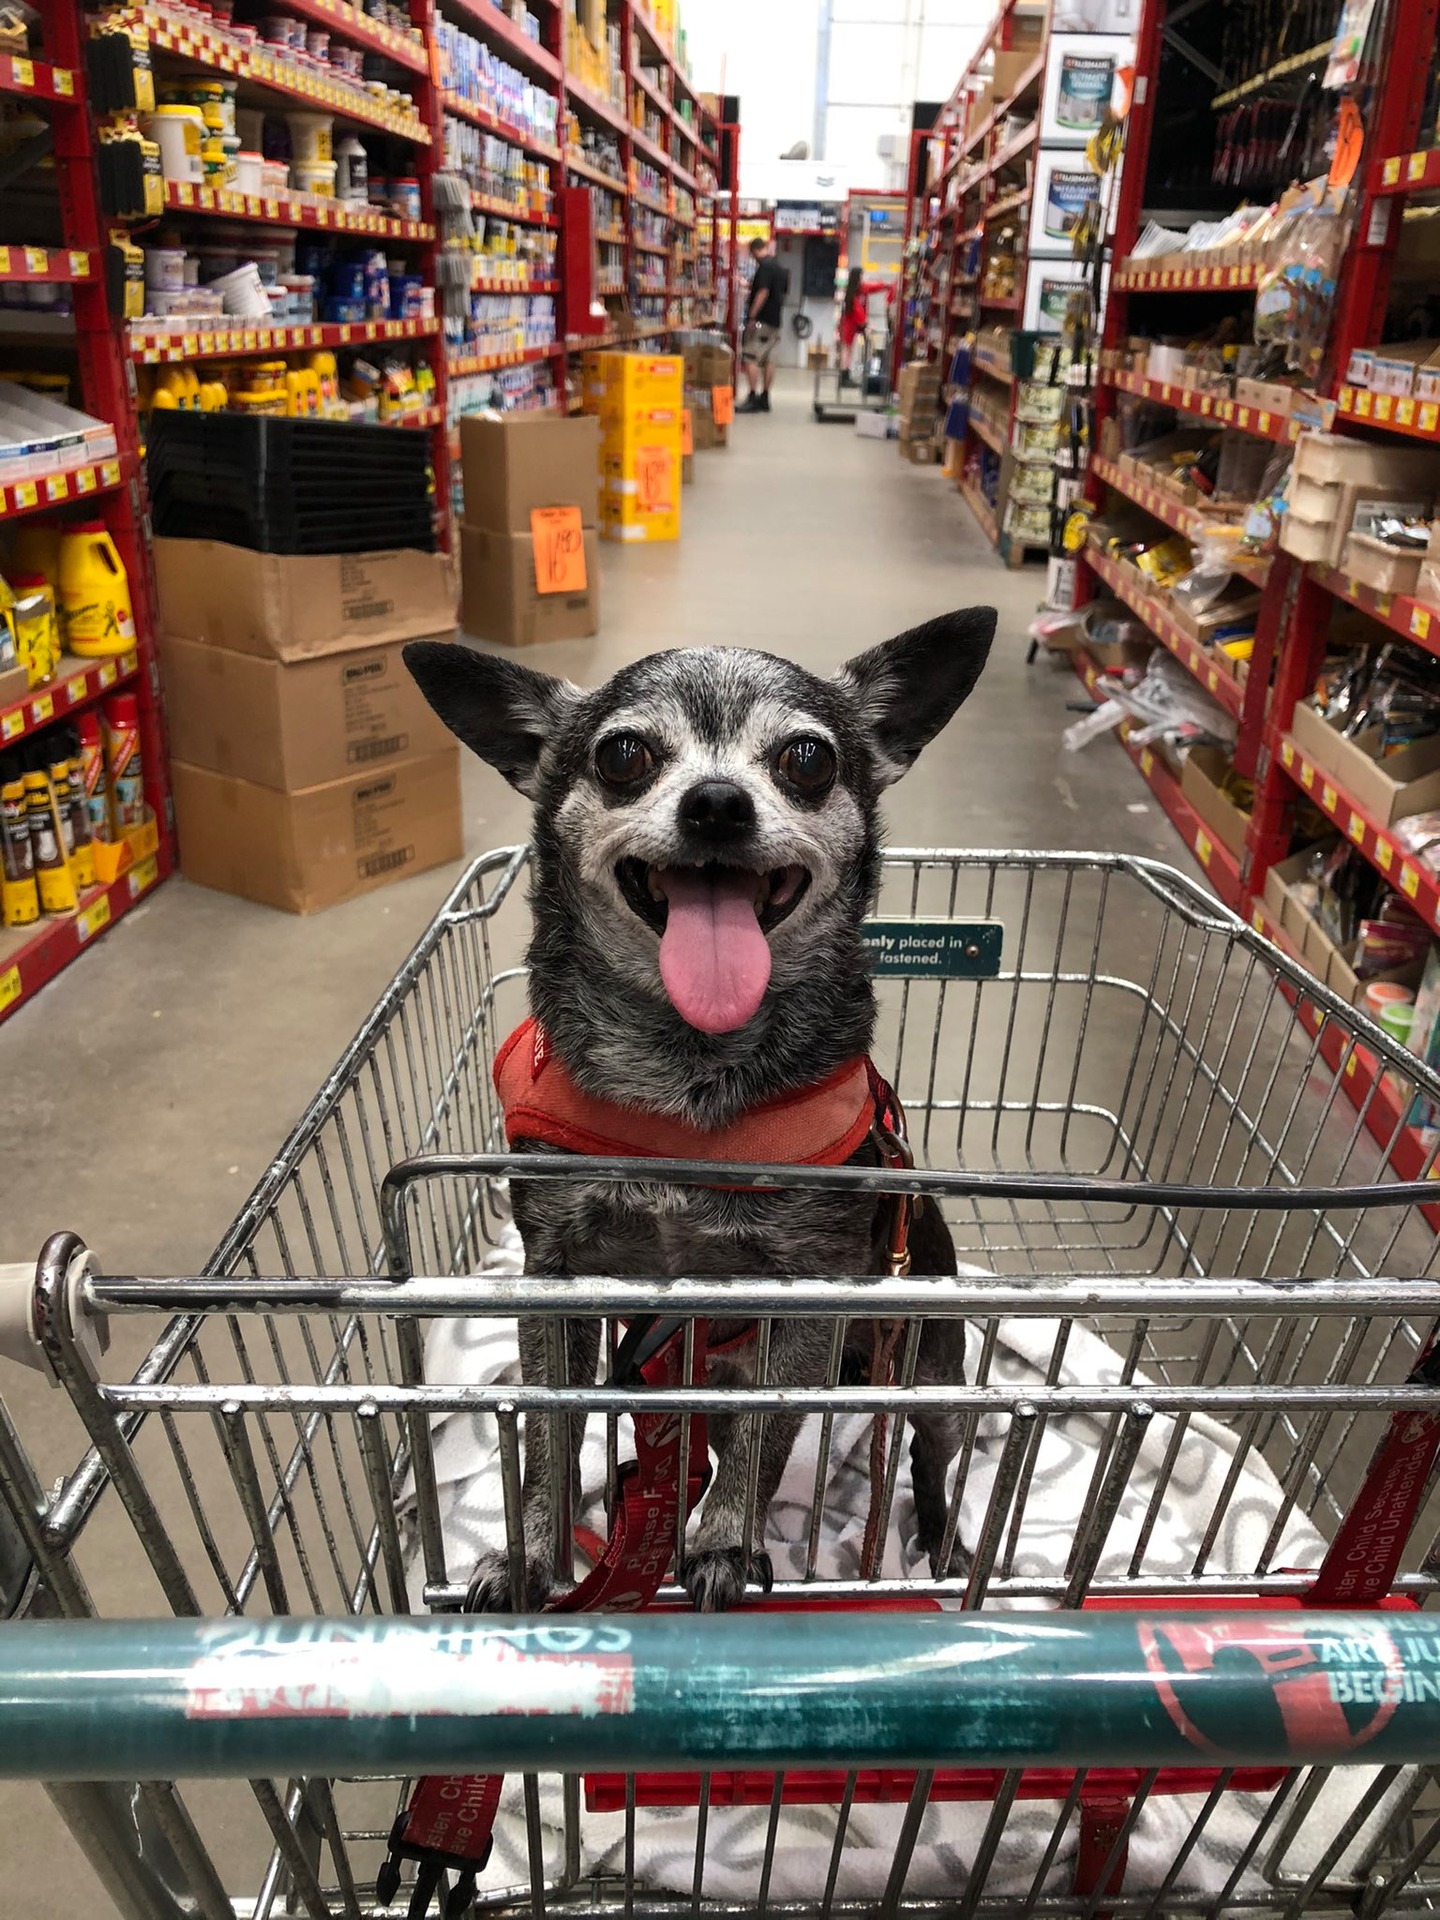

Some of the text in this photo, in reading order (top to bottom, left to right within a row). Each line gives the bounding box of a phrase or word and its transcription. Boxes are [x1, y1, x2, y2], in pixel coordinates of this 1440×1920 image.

[863, 935, 962, 950] only placed in
[880, 952, 942, 964] fastened.
[654, 1512, 675, 1543] Not
[1346, 1523, 1377, 1561] Child
[1364, 1457, 1409, 1521] Securely
[1364, 1535, 1395, 1574] Child
[1381, 1441, 1430, 1531] Unattended
[627, 1507, 660, 1570] Pease
